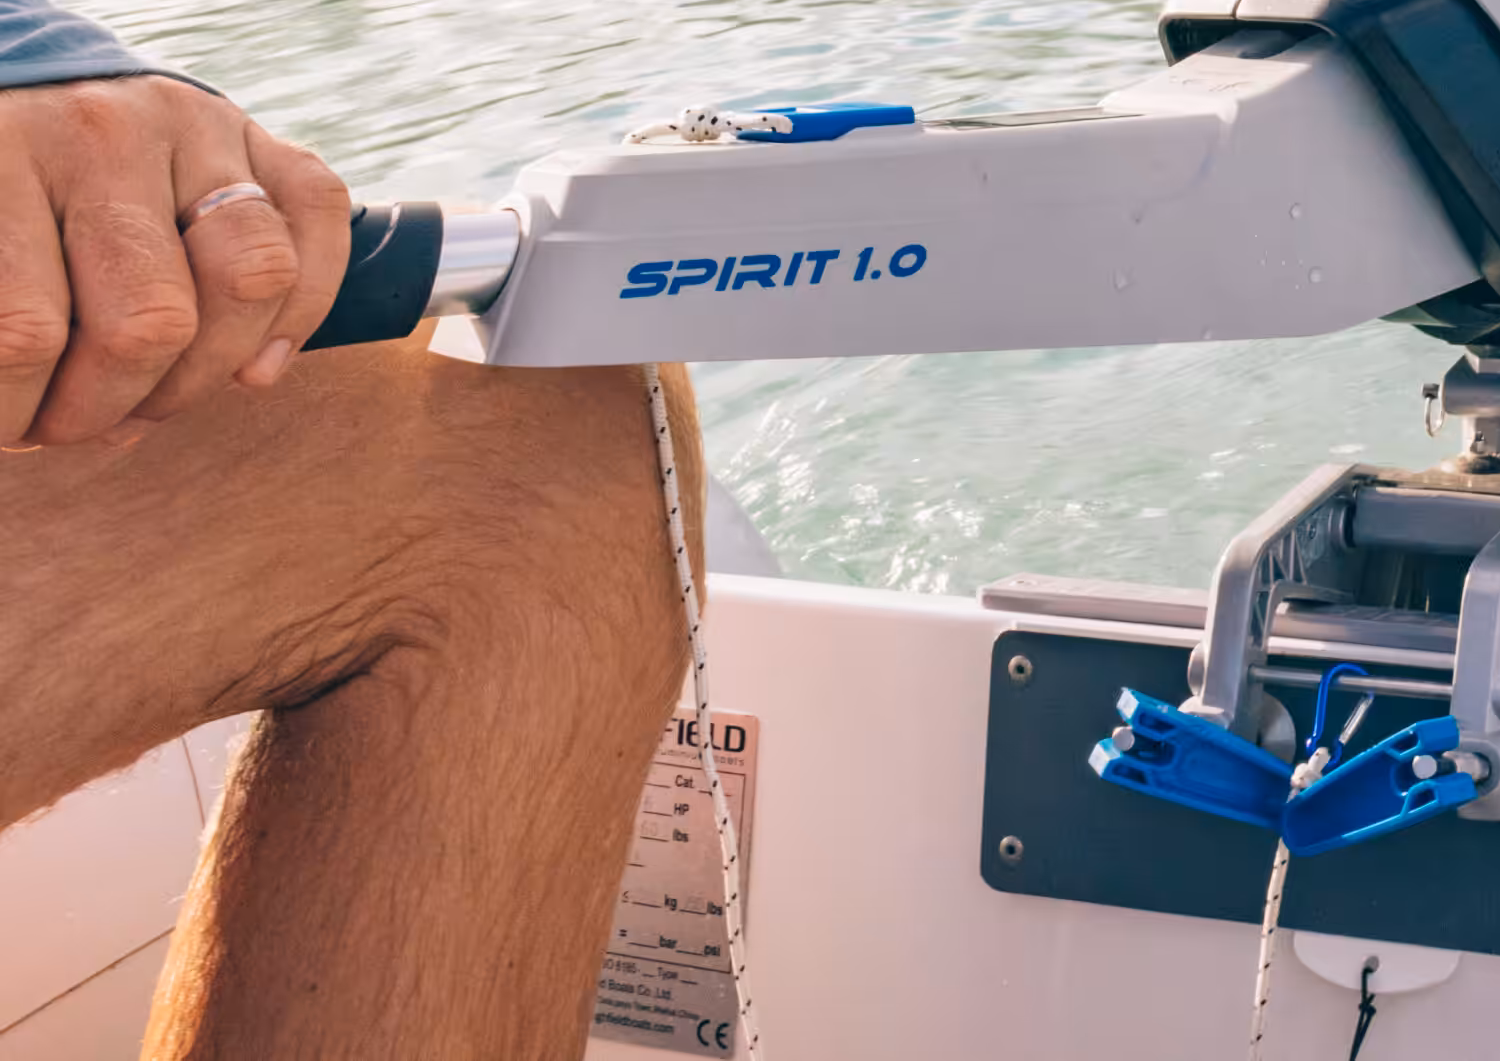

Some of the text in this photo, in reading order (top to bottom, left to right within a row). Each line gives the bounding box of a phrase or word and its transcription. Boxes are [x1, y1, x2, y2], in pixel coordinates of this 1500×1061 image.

[619, 244, 927, 299] SPIRIT 1.0
[674, 802, 690, 816] HP
[672, 828, 689, 843] lbs
[664, 893, 678, 911] kg
[706, 900, 723, 916] lbs
[659, 935, 721, 957] bar psi
